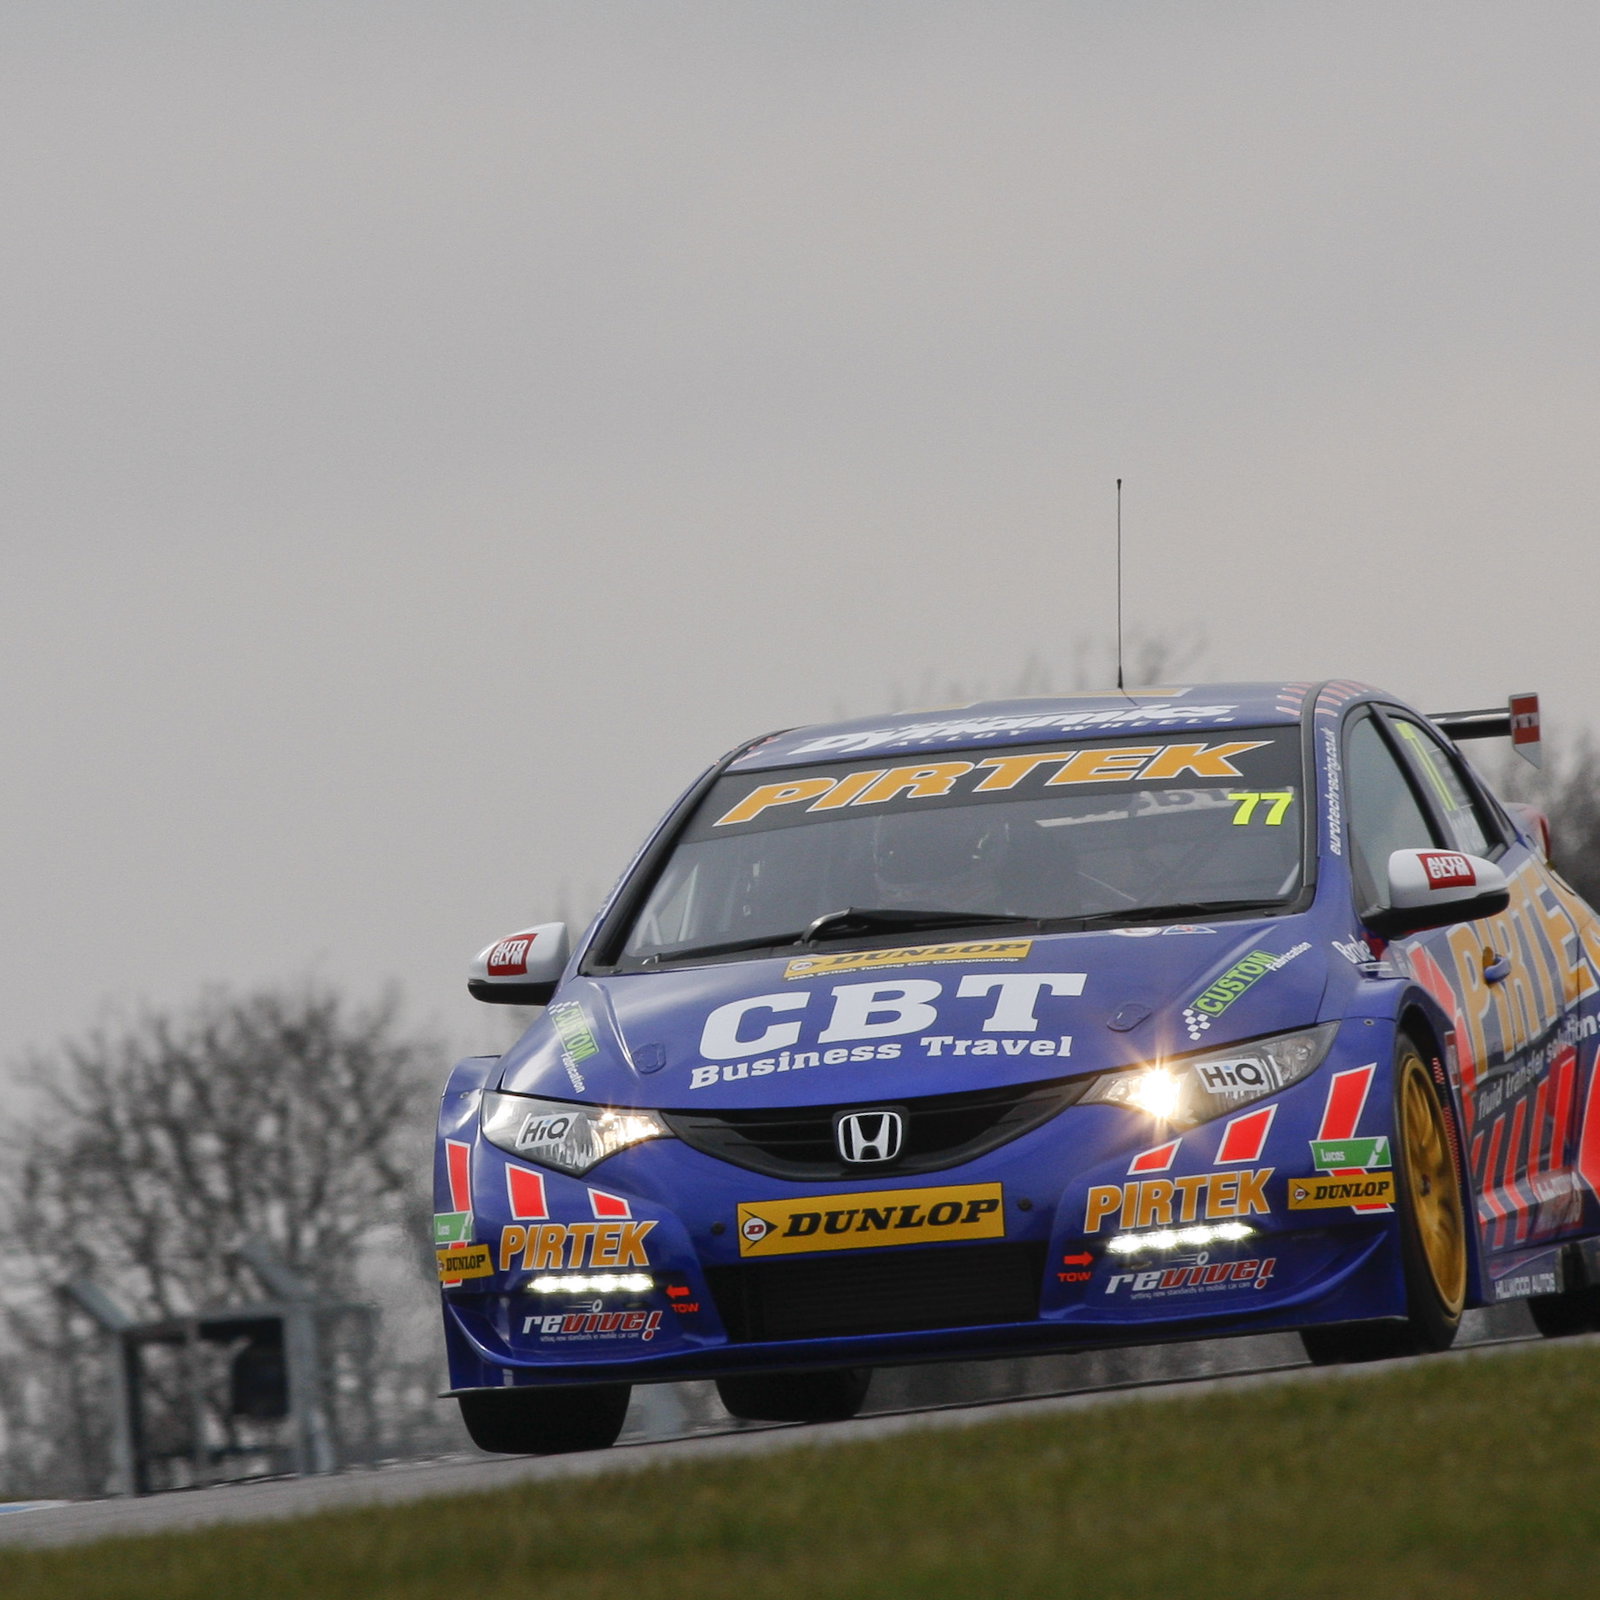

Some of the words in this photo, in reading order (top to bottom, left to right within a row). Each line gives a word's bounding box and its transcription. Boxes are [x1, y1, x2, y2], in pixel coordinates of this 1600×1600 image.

[712, 740, 1276, 827] PIRTEK
[1227, 792, 1294, 826] 77
[1427, 855, 1464, 868] AUTO
[1429, 864, 1472, 880] GLYM
[491, 951, 525, 967] GLYM
[496, 939, 528, 954] AUTO
[827, 943, 1028, 965] DUNLOP
[1196, 951, 1278, 1013] CUSTOM
[1266, 941, 1313, 971] Fabrication
[699, 972, 1088, 1060] CBT
[690, 1043, 902, 1090] Business
[921, 1036, 1073, 1058] Travel
[1201, 1063, 1265, 1089] HiQ
[521, 1117, 570, 1145] HiQ
[1320, 1148, 1346, 1163] Lucas
[1084, 1167, 1275, 1234] PIRTEK
[1313, 1180, 1390, 1201] DUNLOP
[782, 1198, 1000, 1238] DUNLOP
[499, 1220, 660, 1271] PIRTEK
[446, 1254, 486, 1272] DUNLOP
[1105, 1257, 1277, 1294] revive!
[1057, 1272, 1092, 1283] TOW
[671, 1302, 699, 1313] TOW
[522, 1310, 664, 1342] revive!
